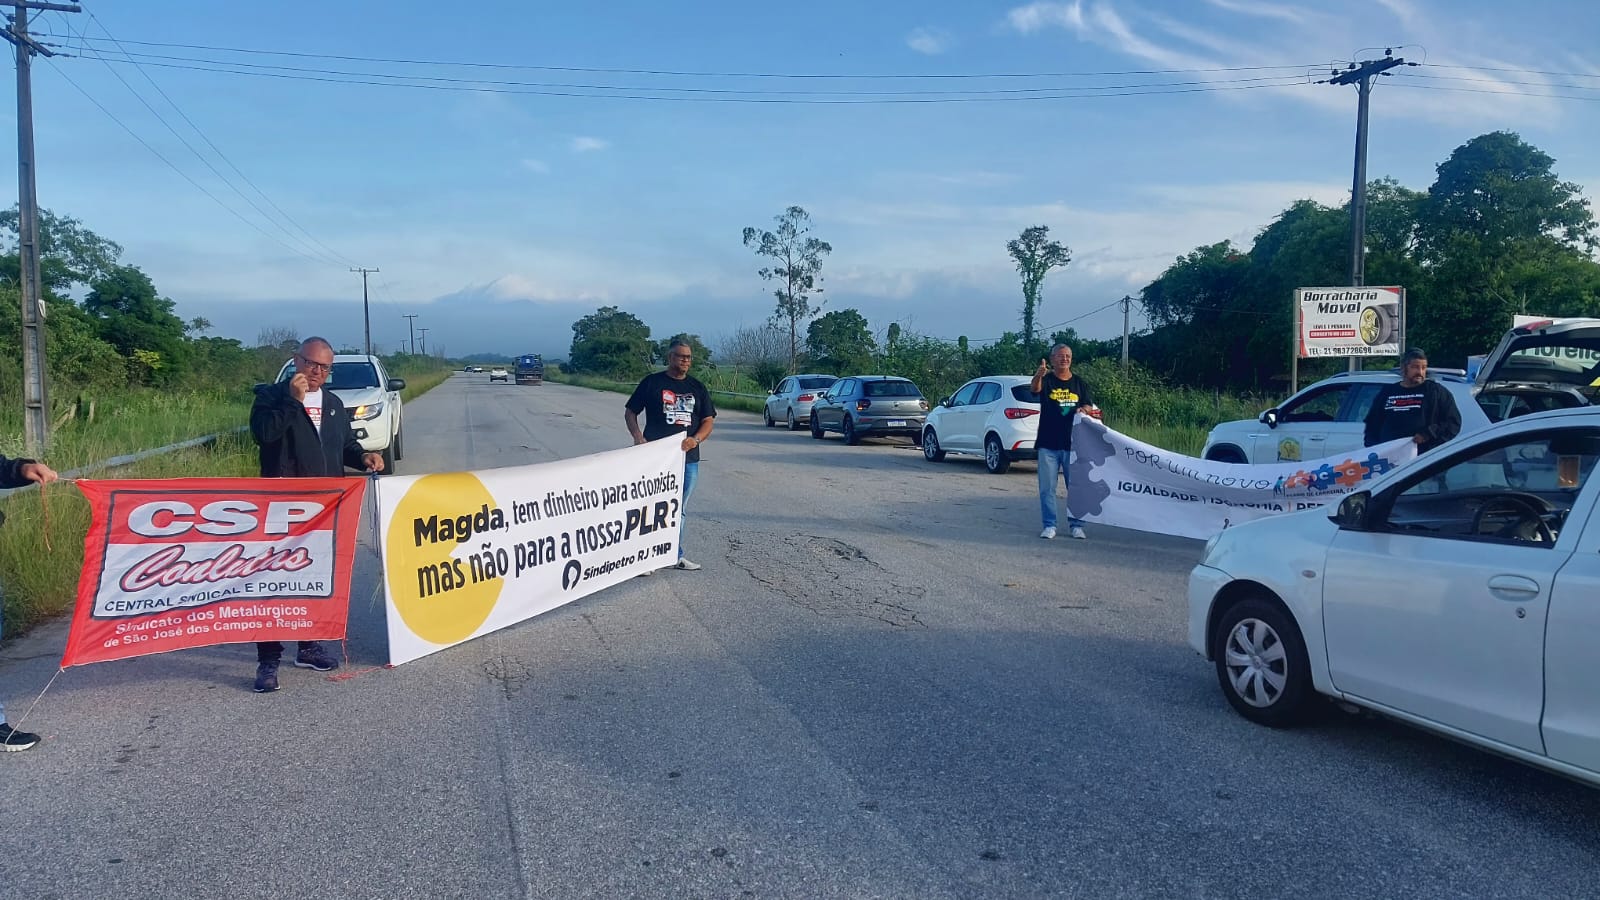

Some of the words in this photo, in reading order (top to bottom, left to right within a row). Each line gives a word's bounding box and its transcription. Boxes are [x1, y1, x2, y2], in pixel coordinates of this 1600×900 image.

[1303, 291, 1377, 301] Borracharia
[1118, 481, 1199, 502] IGUALDADE
[128, 501, 324, 537] CSP
[413, 503, 510, 547] Magda,
[513, 500, 541, 526] tem
[544, 486, 599, 520] dinheiro
[601, 484, 628, 510] para
[630, 471, 678, 494] acionista,
[417, 555, 466, 598] mas
[469, 542, 509, 585] não
[513, 535, 556, 578] para
[561, 532, 572, 558] a
[575, 519, 622, 555] nossa
[624, 498, 679, 540] PLR?
[119, 544, 313, 593] Conlutas
[583, 555, 635, 580] Sindipetro
[637, 548, 649, 562] RJ
[104, 598, 174, 611] CENTRAL
[178, 588, 241, 604] SINDICAL
[245, 583, 254, 592] E
[259, 582, 324, 592] POPULAR
[103, 638, 119, 648] de
[123, 634, 148, 645] São
[153, 627, 183, 640] José
[187, 625, 210, 634] dos
[213, 621, 262, 632] Campos
[276, 618, 313, 630] Região
[115, 617, 182, 635] Sindicato
[187, 610, 215, 622] dos
[219, 604, 308, 619] Metalúrgicos
